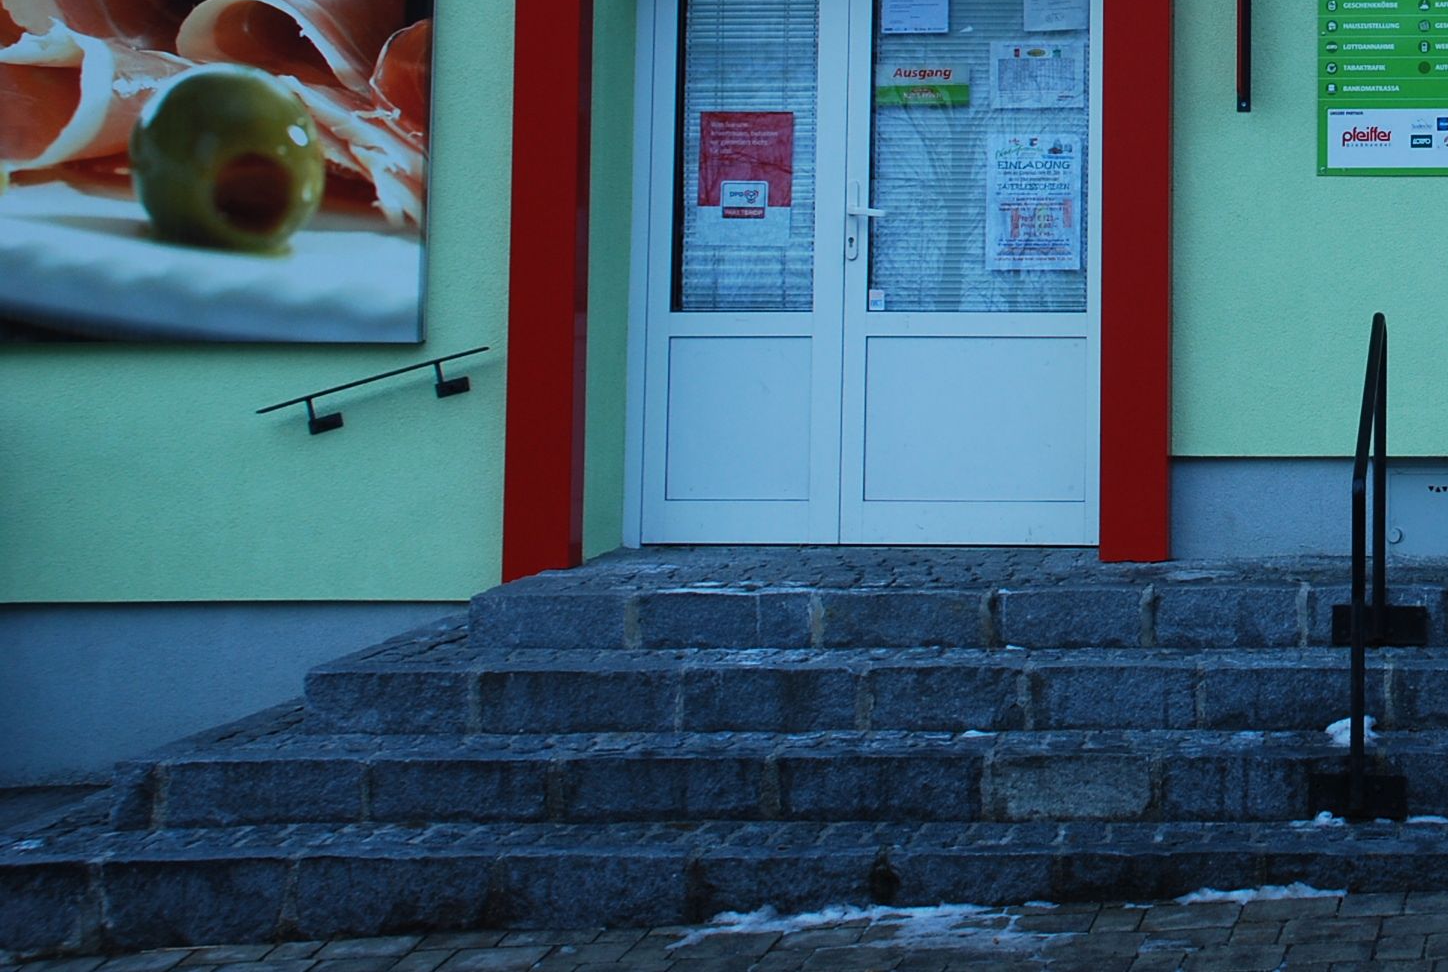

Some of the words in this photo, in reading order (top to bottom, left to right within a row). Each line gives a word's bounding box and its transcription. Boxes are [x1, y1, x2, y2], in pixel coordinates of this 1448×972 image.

[893, 68, 953, 80] Ausgang
[1342, 126, 1391, 147] pfeiffer
[997, 161, 1071, 170] EINLADUNG
